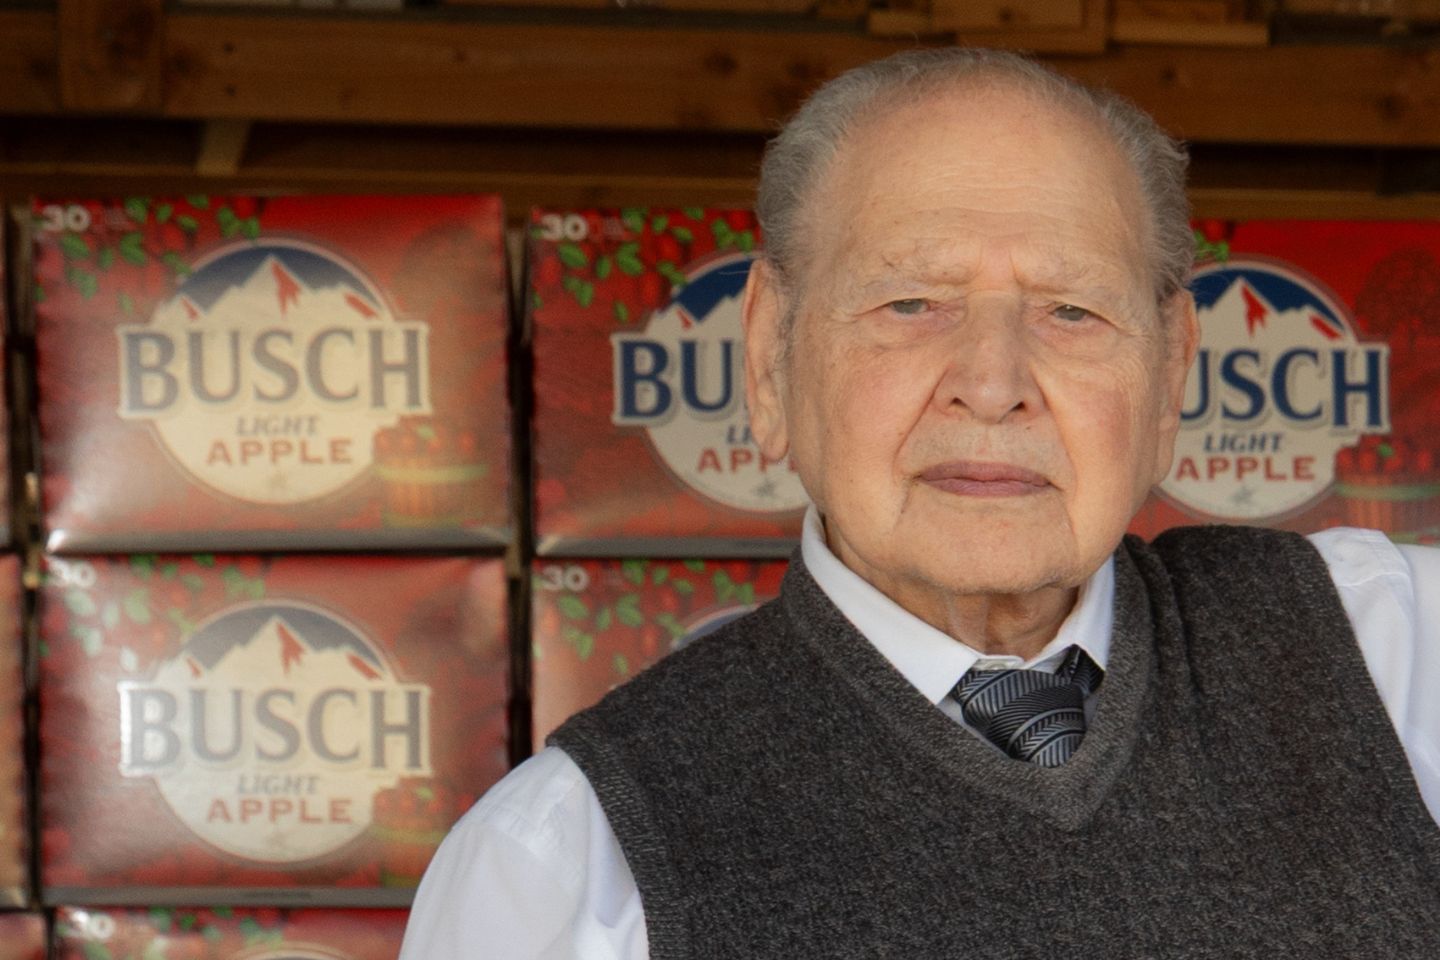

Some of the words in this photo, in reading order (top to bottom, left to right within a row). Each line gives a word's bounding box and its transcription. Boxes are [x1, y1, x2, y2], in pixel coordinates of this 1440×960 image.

[43, 206, 90, 231] 30
[542, 215, 588, 241] 30
[123, 327, 424, 412] BUSCH
[236, 415, 321, 437] LIGHT
[206, 438, 354, 465] APPLE
[1204, 433, 1283, 452] LIGHT
[1176, 456, 1315, 482] APPLE
[542, 566, 589, 592] 30
[126, 687, 424, 773] BUSCH
[236, 774, 320, 795] LIGHT
[206, 798, 353, 825] APPLE
